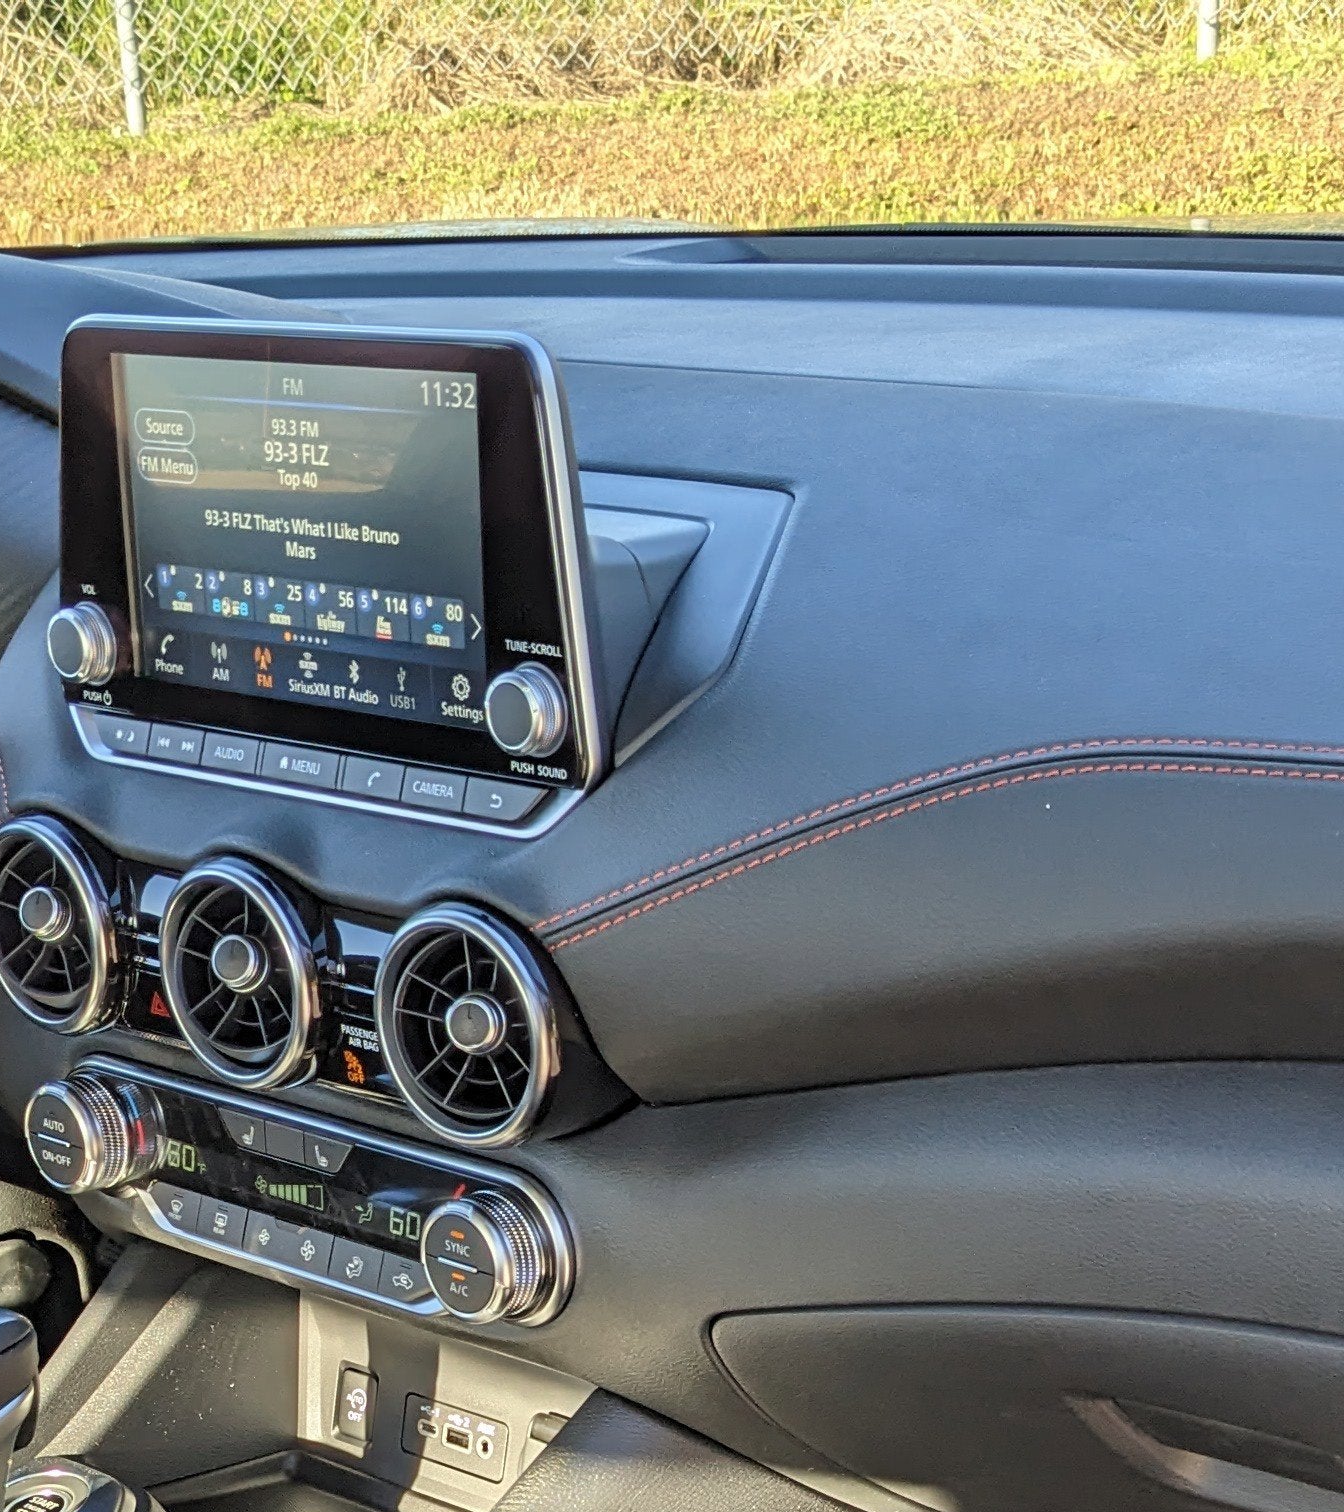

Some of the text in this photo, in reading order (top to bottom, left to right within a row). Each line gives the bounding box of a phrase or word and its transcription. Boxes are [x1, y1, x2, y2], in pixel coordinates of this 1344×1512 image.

[283, 377, 304, 396] FM
[420, 381, 475, 409] 11:32
[145, 418, 183, 436] Source
[271, 418, 319, 438] 93.3 FM
[264, 441, 330, 467] 93-3 FLZ
[141, 456, 193, 476] FM Menu
[277, 469, 318, 490] Top 40
[205, 510, 400, 545] 93-3 FLZ That's What I Like Bruno
[285, 541, 317, 560] Mars
[194, 573, 204, 590] 2
[243, 579, 252, 595] 8
[287, 584, 302, 602] 25
[338, 590, 355, 608] 56
[385, 597, 408, 615] 114
[445, 603, 463, 622] 80
[155, 658, 184, 675] Phone
[212, 668, 230, 681] AM
[257, 673, 273, 688] FM
[288, 678, 330, 698] SiriusXM
[333, 684, 379, 705] BT Audio
[390, 694, 416, 710] USB1
[441, 702, 484, 724] Settings
[214, 746, 244, 762] AUDIO
[291, 758, 321, 775] MENU
[510, 760, 568, 780] PUSH SOUND
[412, 780, 453, 798] CAMERA
[340, 1023, 378, 1041] PASSENGE
[348, 1036, 380, 1052] AIR BAG
[43, 1117, 65, 1133] AUTO
[389, 1205, 421, 1241] 60
[445, 1239, 471, 1258] SYNC
[449, 1282, 469, 1298] A/C
[28, 1496, 60, 1510] START
